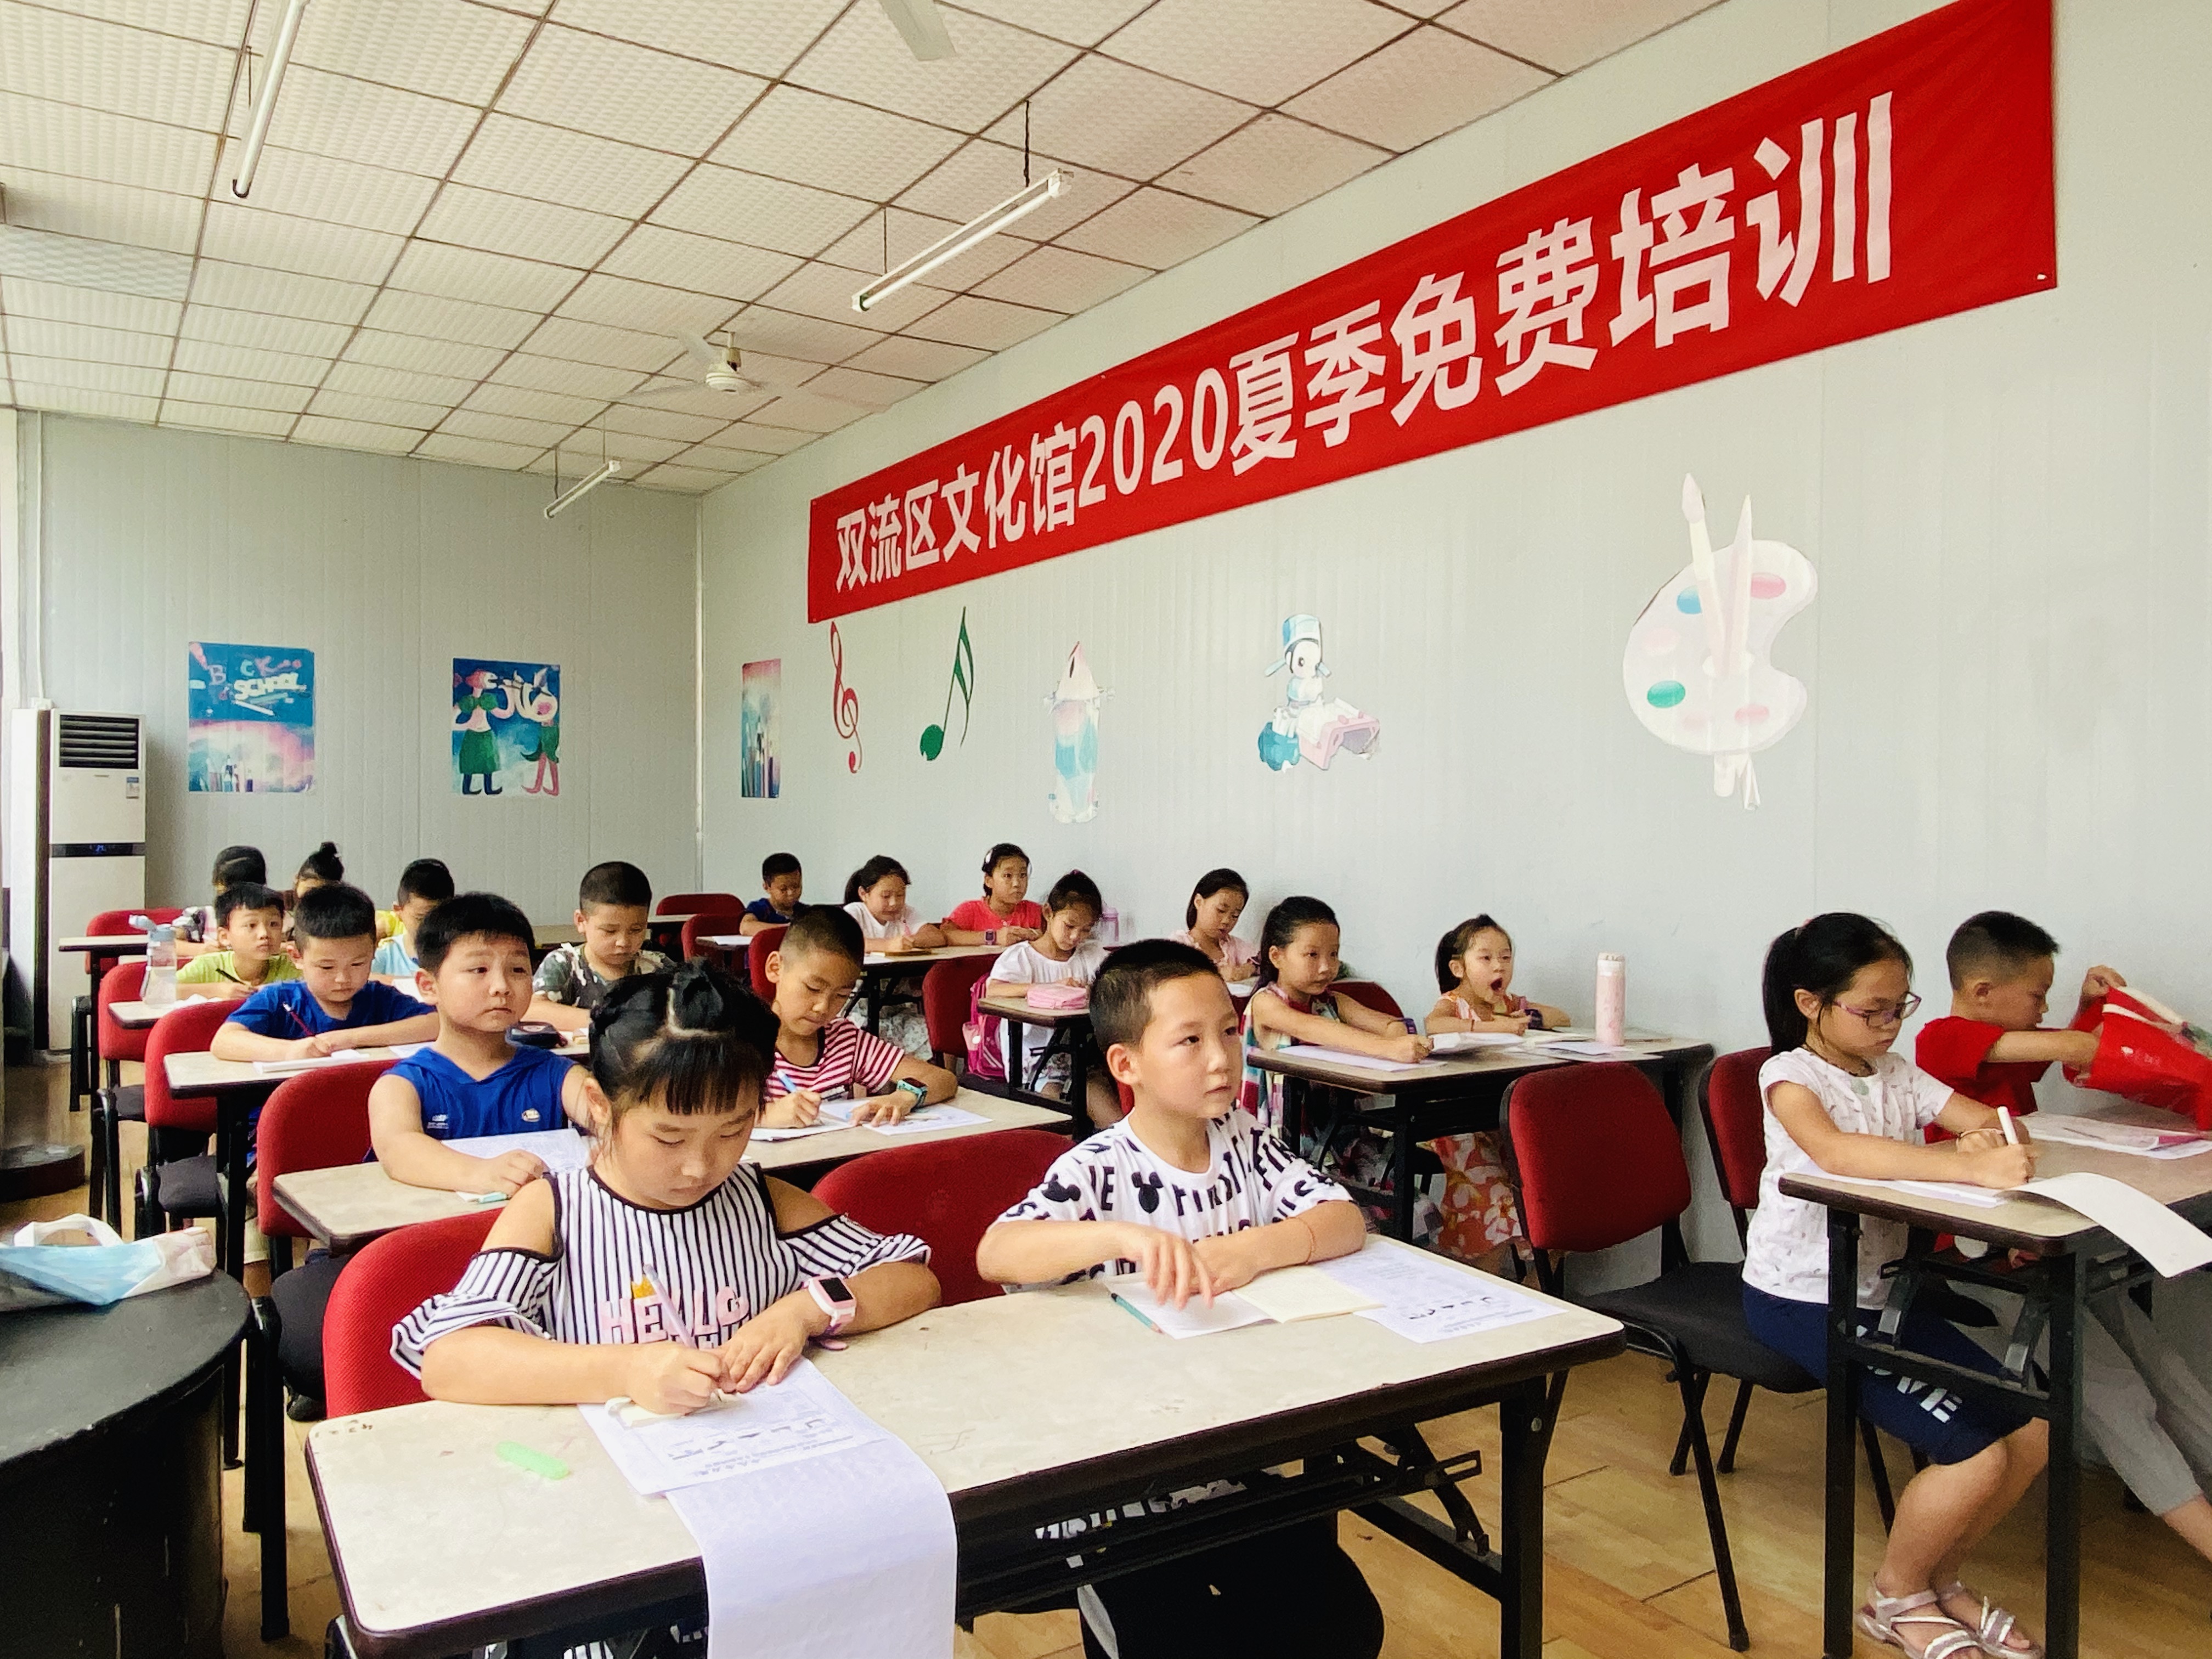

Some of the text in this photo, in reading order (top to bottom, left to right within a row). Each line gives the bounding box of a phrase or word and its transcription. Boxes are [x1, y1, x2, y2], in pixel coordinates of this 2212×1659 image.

[836, 91, 1893, 593] 双流区文化馆2020夏季免费培训
